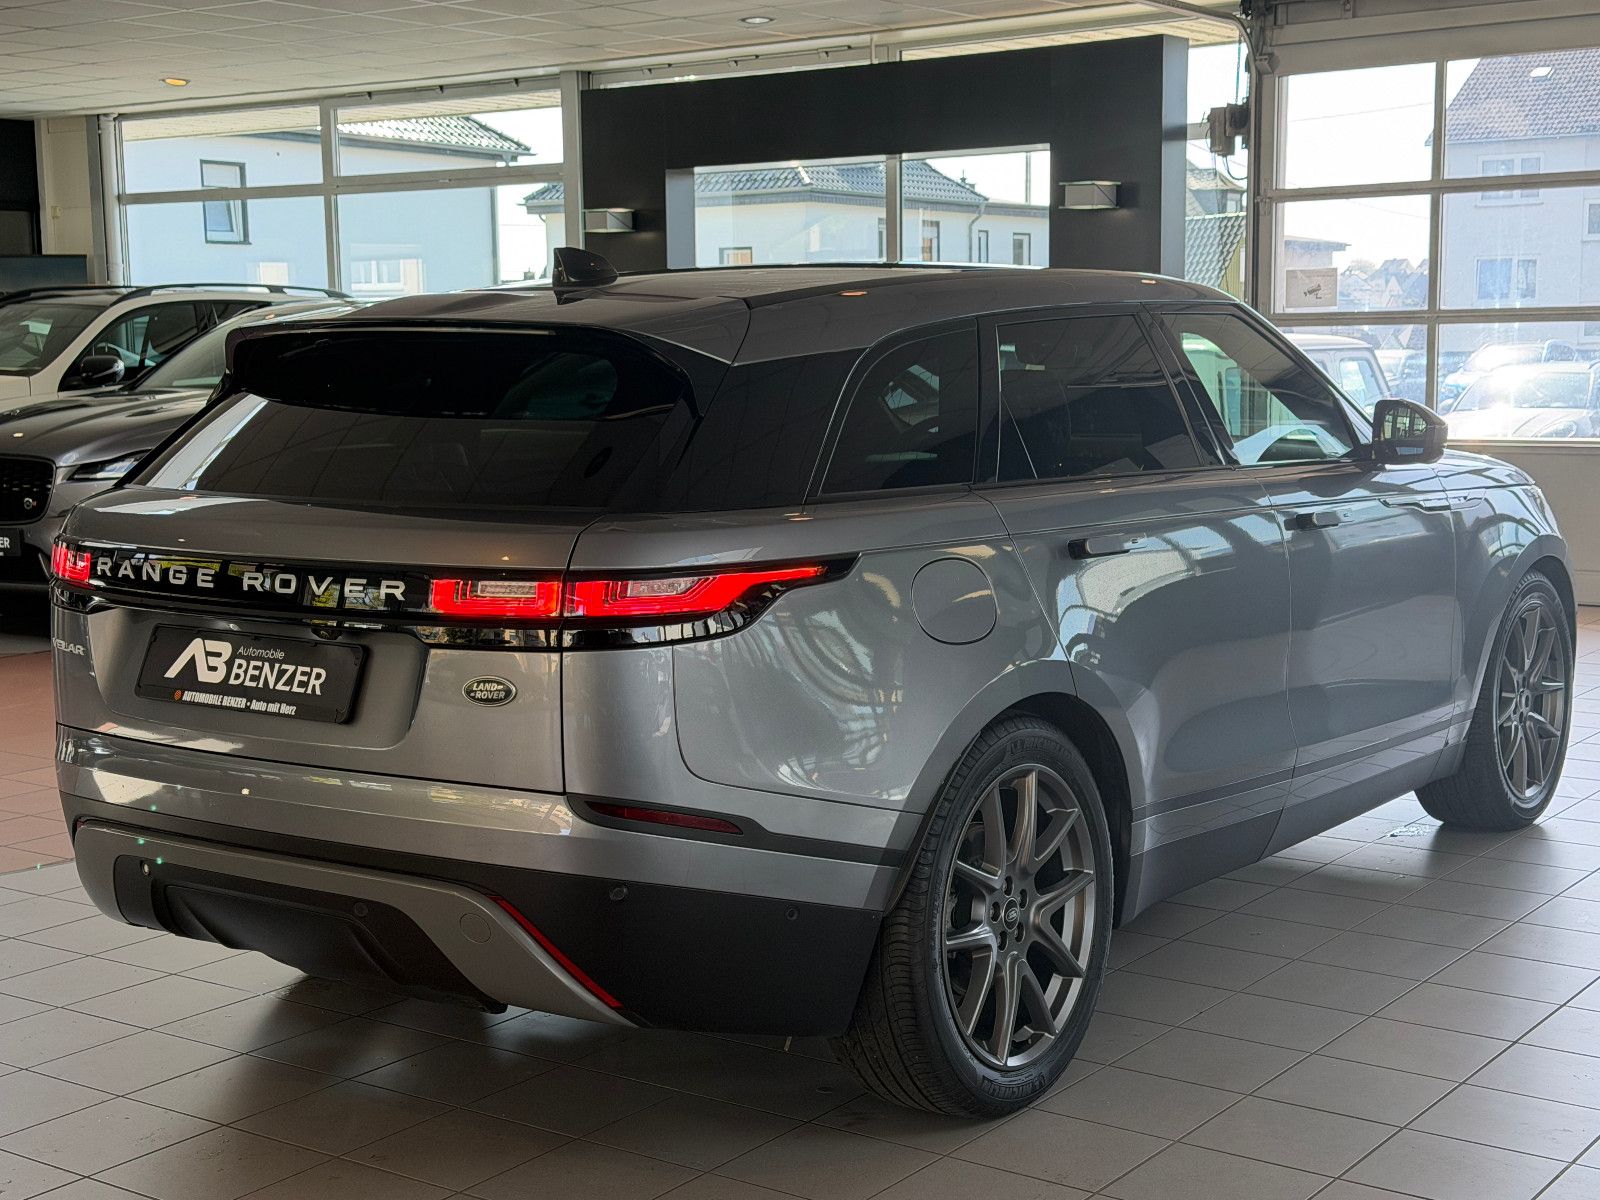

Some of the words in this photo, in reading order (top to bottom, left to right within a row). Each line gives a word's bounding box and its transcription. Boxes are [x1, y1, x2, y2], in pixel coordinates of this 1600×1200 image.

[96, 556, 216, 589] RANGE
[242, 571, 406, 601] ROVER
[236, 645, 285, 660] Automobile
[228, 658, 327, 696] BENZER
[182, 690, 223, 706] AUTOMOBILE
[222, 695, 247, 709] BENZER
[250, 699, 268, 712] Auto
[267, 702, 280, 714] mit
[280, 703, 297, 716] Herz
